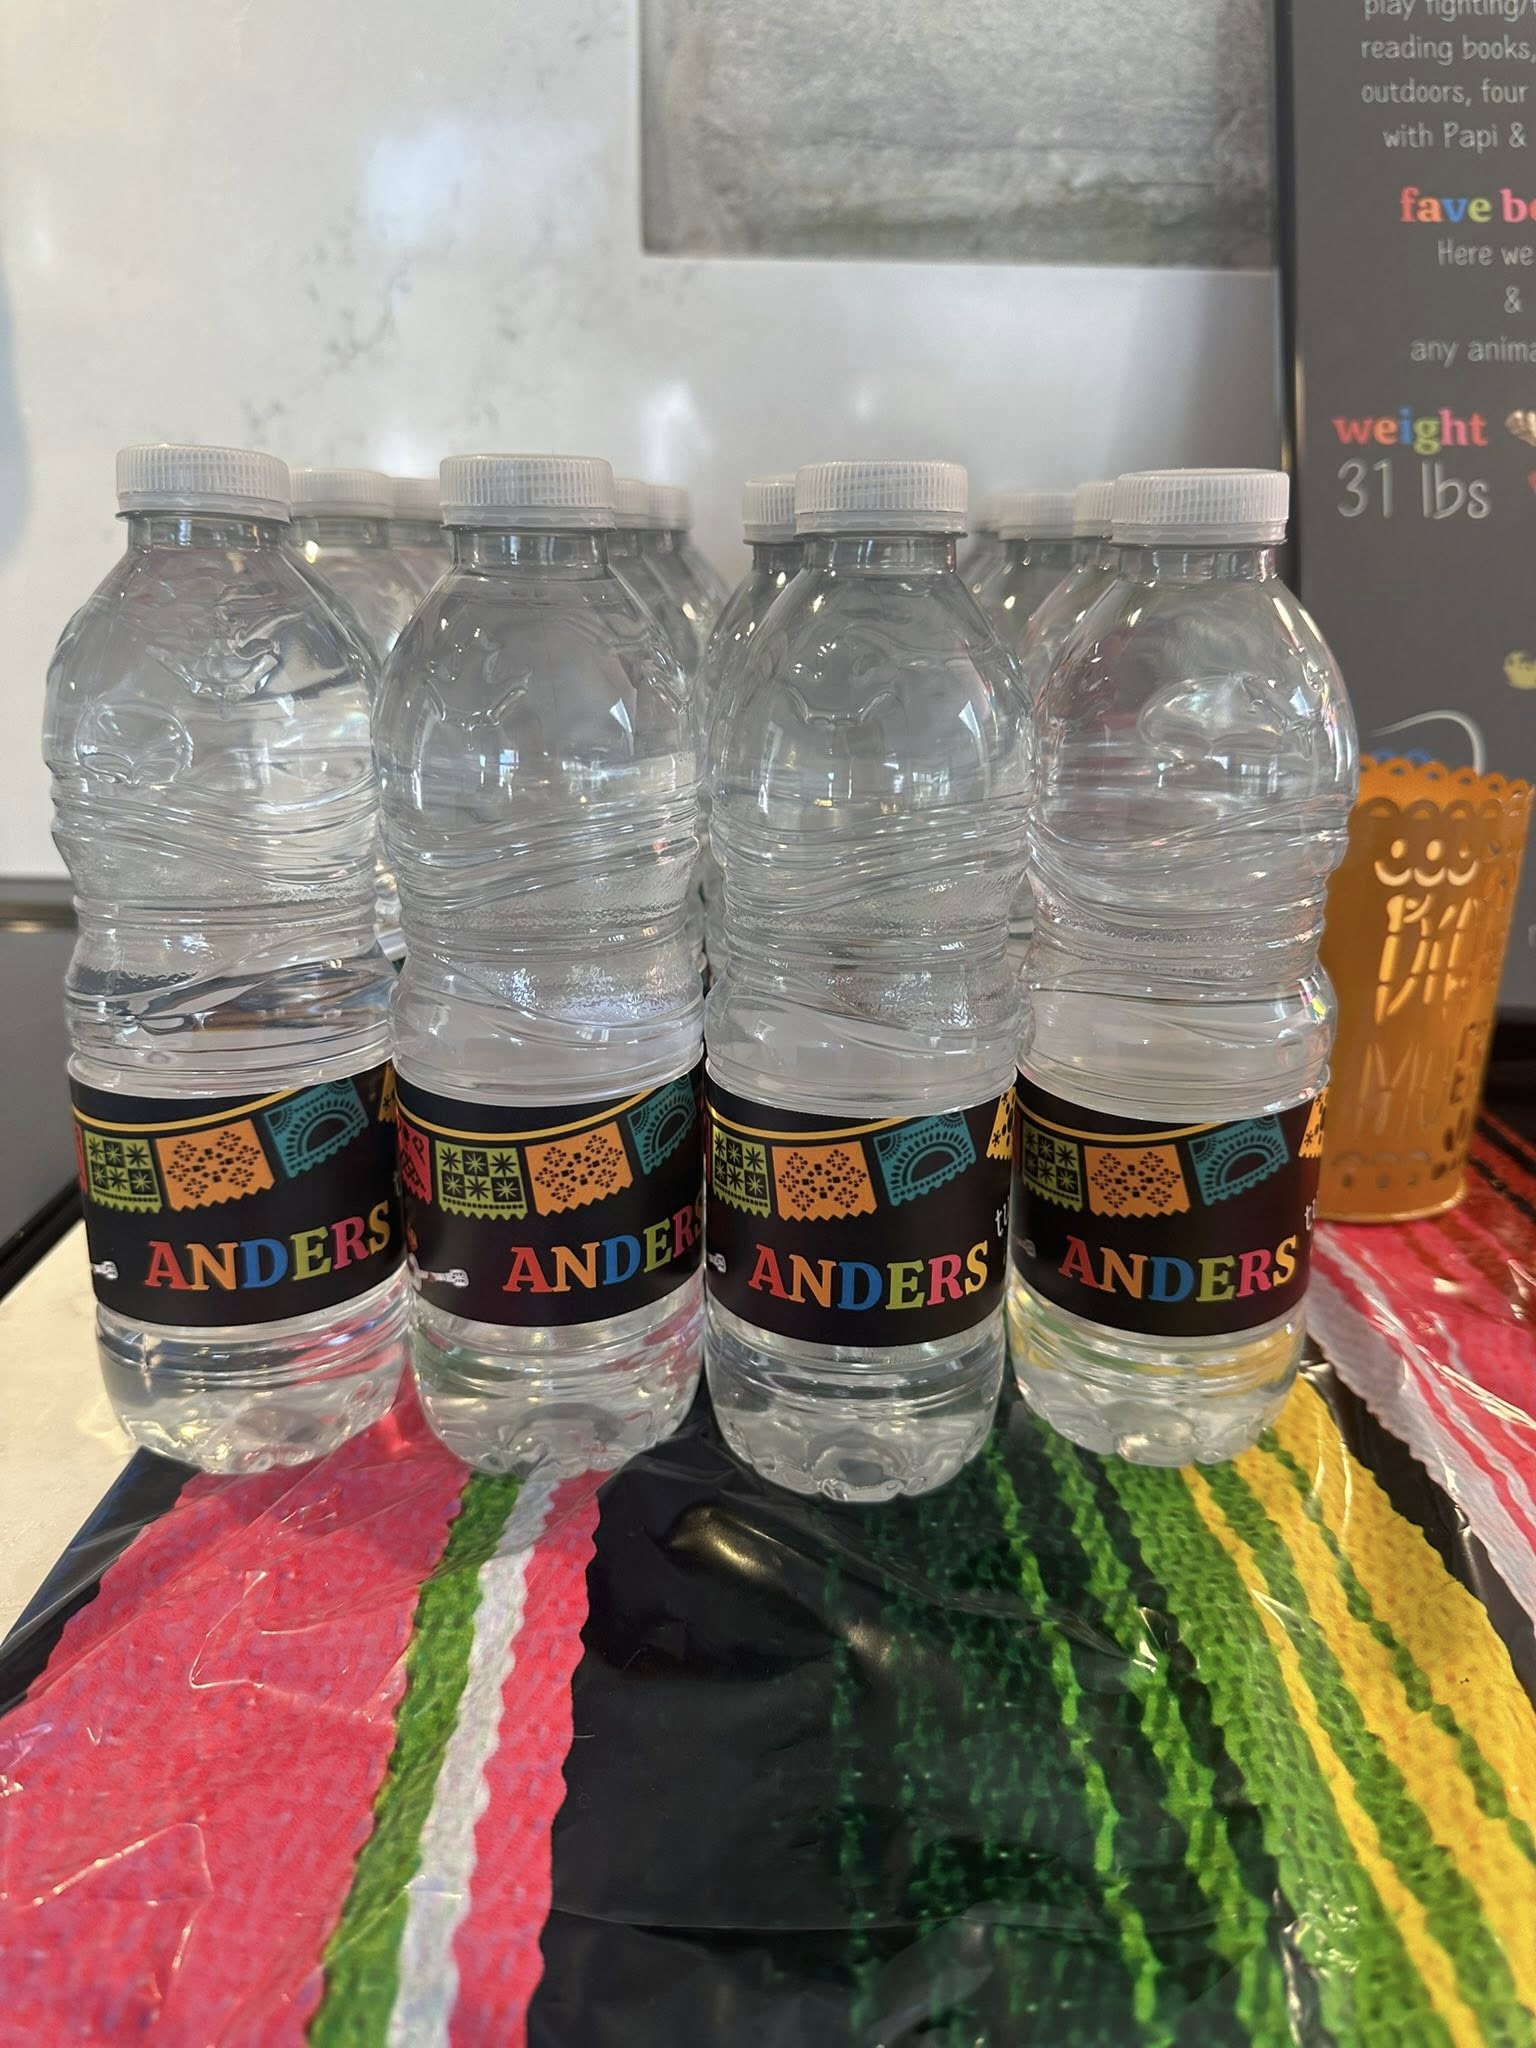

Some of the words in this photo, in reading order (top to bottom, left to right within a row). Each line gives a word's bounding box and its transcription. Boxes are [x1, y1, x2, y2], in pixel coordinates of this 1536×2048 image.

[1364, 0, 1415, 21] play
[1361, 33, 1453, 66] reading
[1462, 33, 1536, 64] books,
[1361, 76, 1472, 107] outdoors,
[1481, 76, 1529, 103] four
[1383, 121, 1433, 148] with
[1444, 120, 1498, 154] Papi
[1508, 121, 1527, 148] &
[1400, 186, 1492, 223] fave
[1438, 238, 1492, 266] Here
[1501, 245, 1534, 266] we
[1504, 285, 1524, 314] &
[1410, 340, 1459, 368] any
[1333, 406, 1488, 455] weight
[1336, 458, 1394, 518] 31
[1421, 459, 1491, 520] lbs
[145, 1200, 391, 1292] ANDERS
[748, 1239, 988, 1311] ANDERS
[1057, 1234, 1297, 1303] ANDERS
